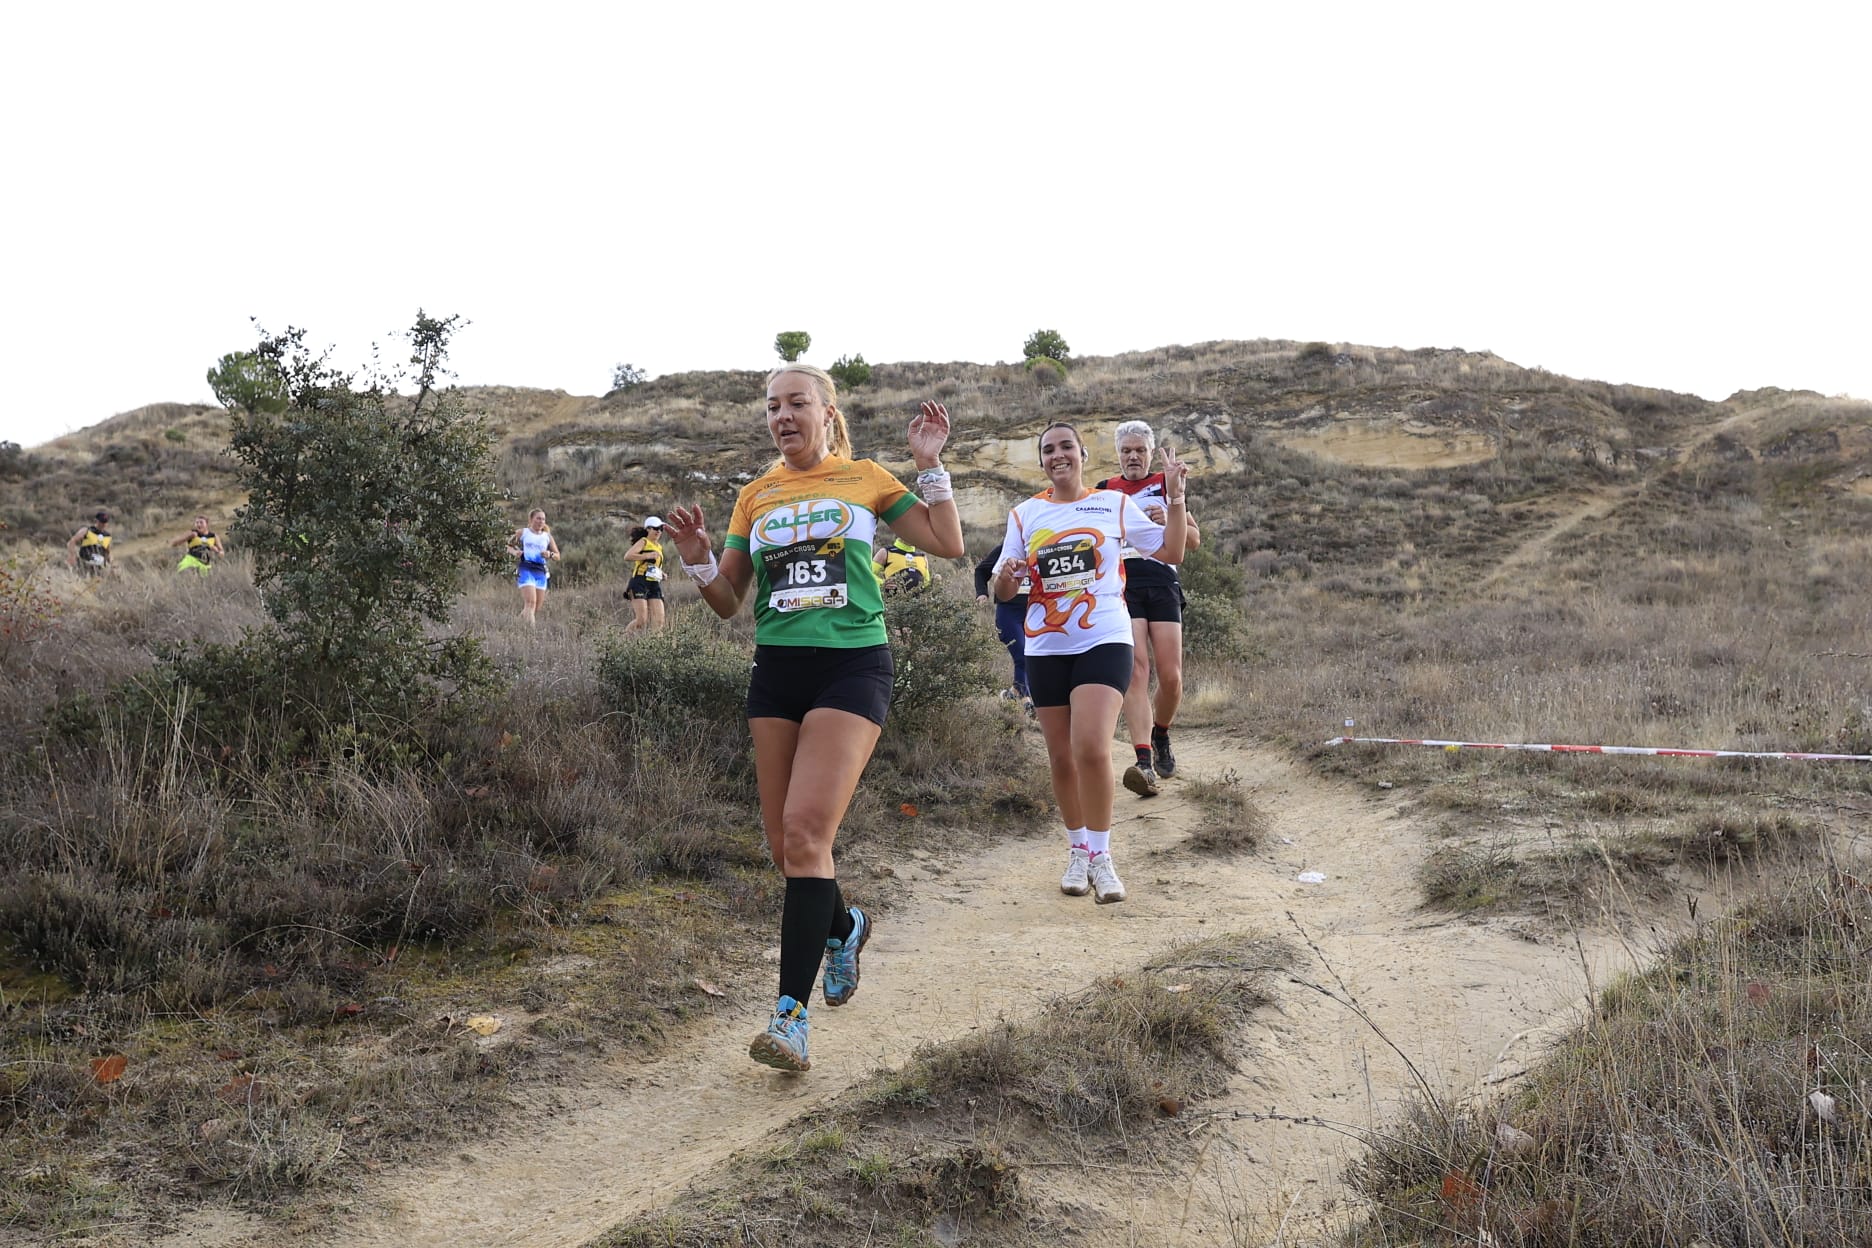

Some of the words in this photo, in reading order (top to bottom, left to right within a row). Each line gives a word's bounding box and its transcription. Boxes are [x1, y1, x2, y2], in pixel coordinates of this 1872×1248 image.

[763, 509, 843, 532] ALCER
[764, 554, 774, 562] 33
[773, 550, 789, 560] LIGA
[1047, 554, 1085, 575] 254
[785, 559, 827, 585] 163
